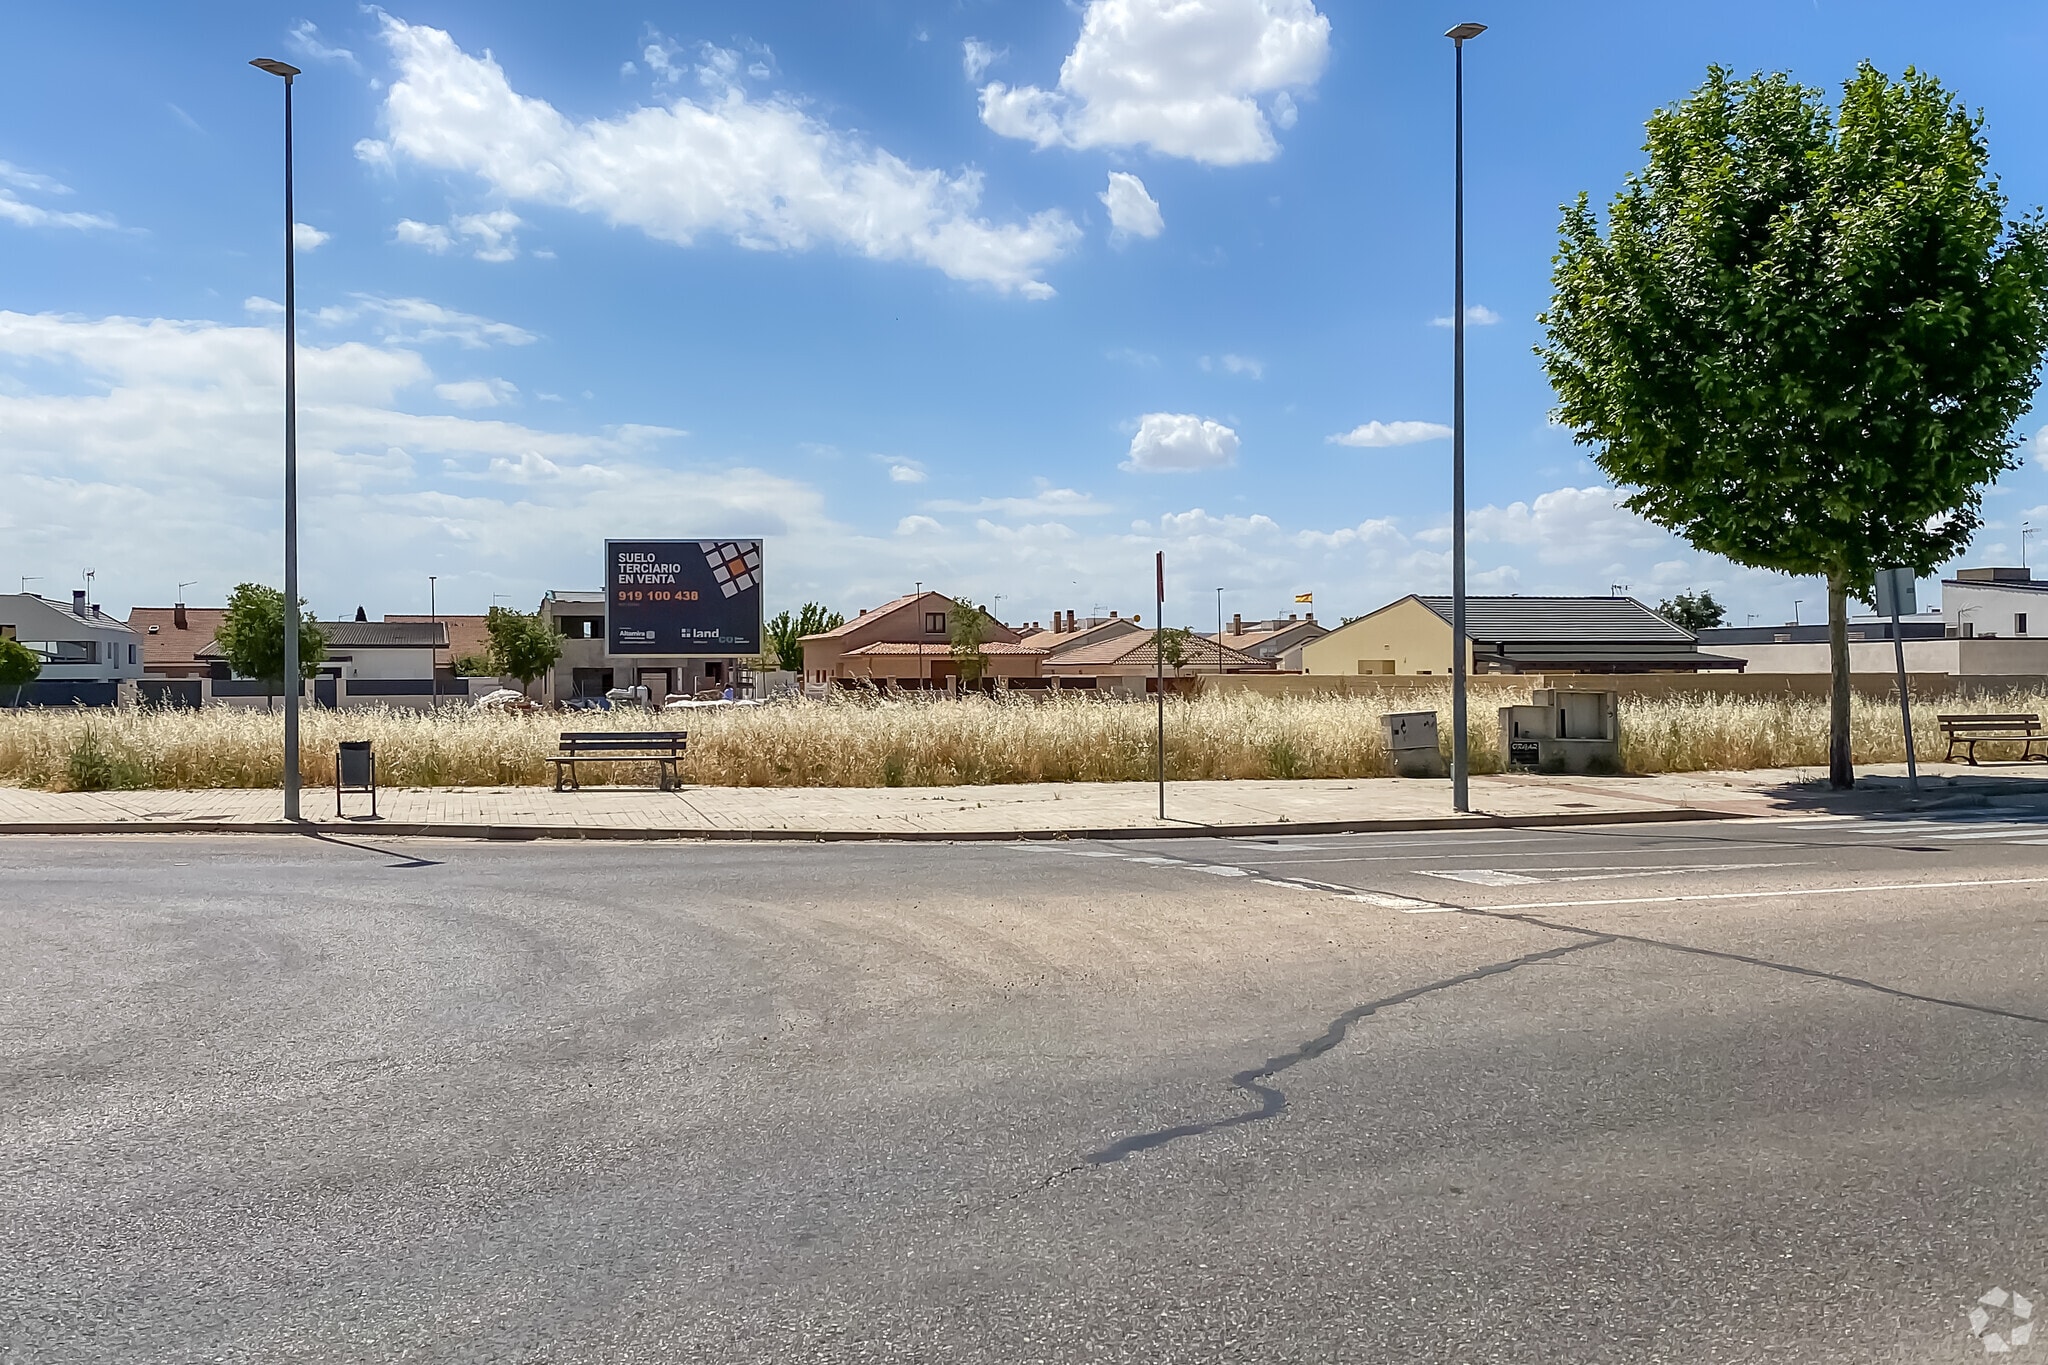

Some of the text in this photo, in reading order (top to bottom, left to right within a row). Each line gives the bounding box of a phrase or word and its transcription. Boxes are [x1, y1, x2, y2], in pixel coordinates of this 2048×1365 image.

[618, 553, 656, 563] SUELO
[618, 563, 681, 573] TERCIARIO
[618, 574, 676, 584] EN VENTA
[618, 591, 699, 601] 919 100 438
[693, 628, 719, 638] land
